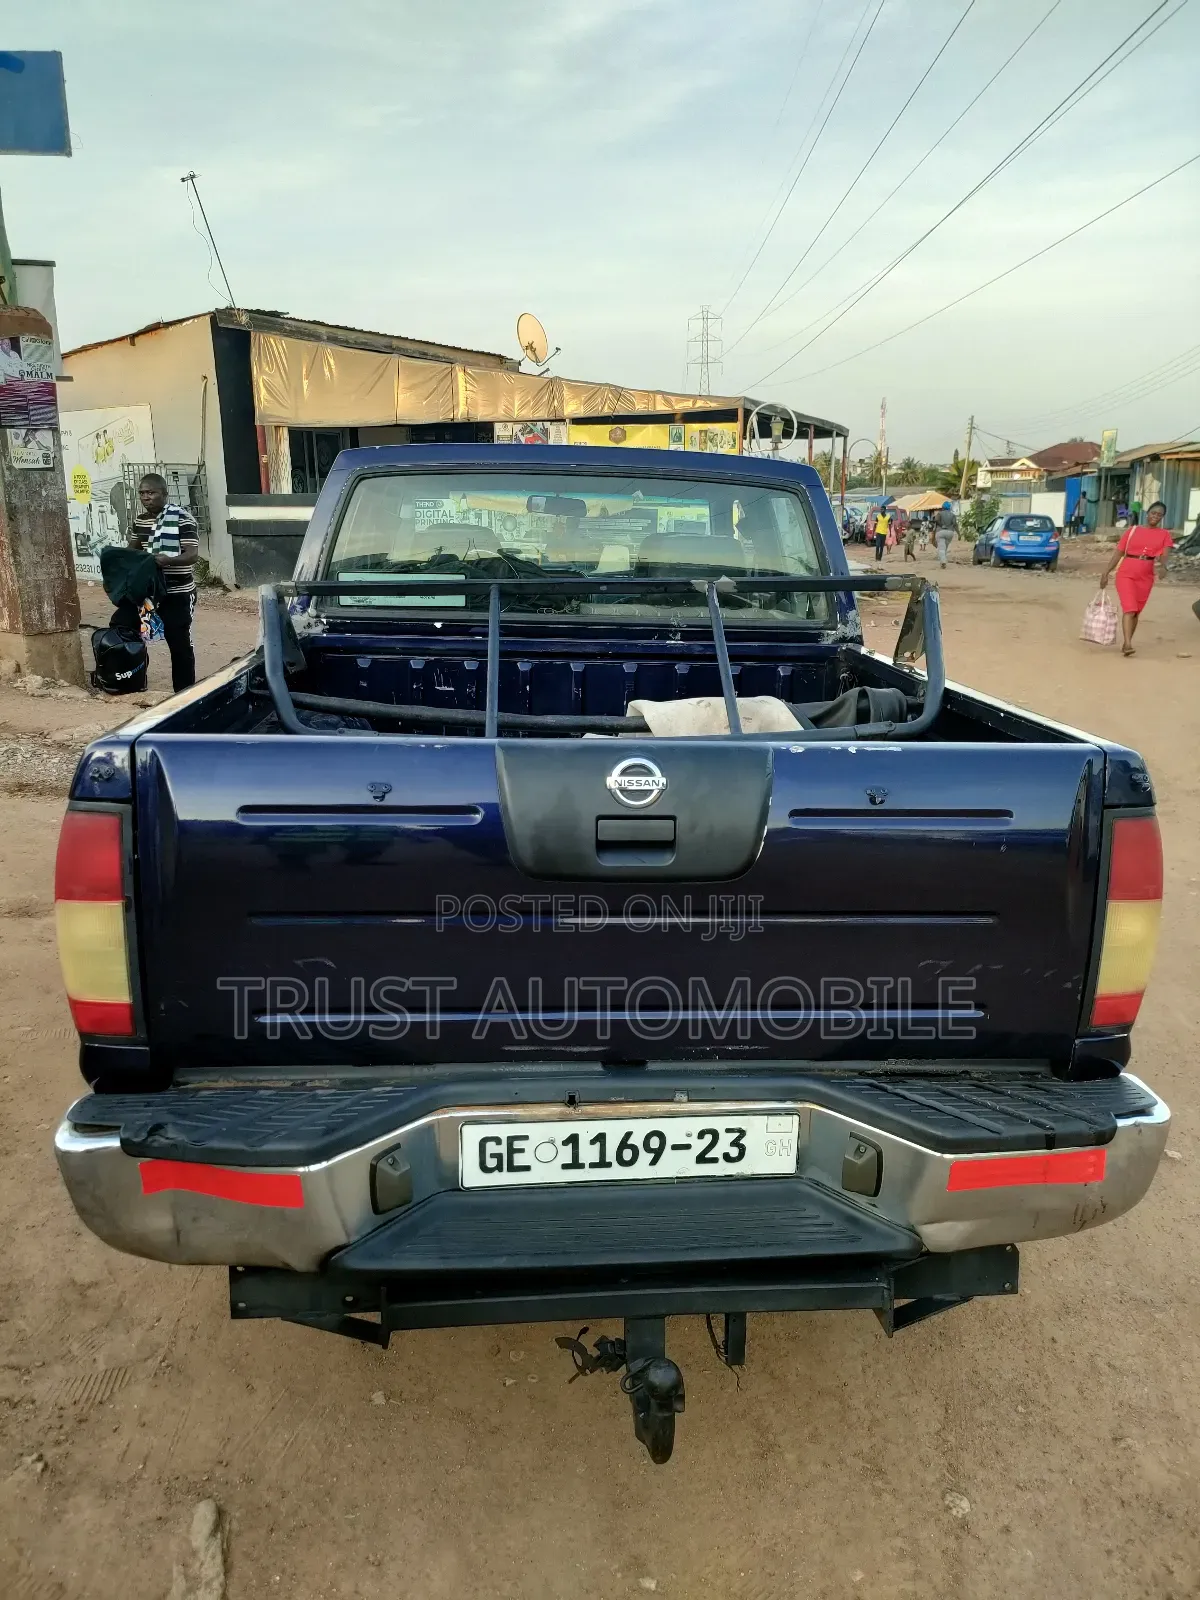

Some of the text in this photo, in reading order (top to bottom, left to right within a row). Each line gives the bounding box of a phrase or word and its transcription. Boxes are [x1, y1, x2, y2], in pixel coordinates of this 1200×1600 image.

[415, 510, 455, 519] DIGITAL
[614, 779, 660, 787] NISSAN
[478, 1127, 747, 1174] GE 1169-23
[764, 1139, 792, 1157] GH
